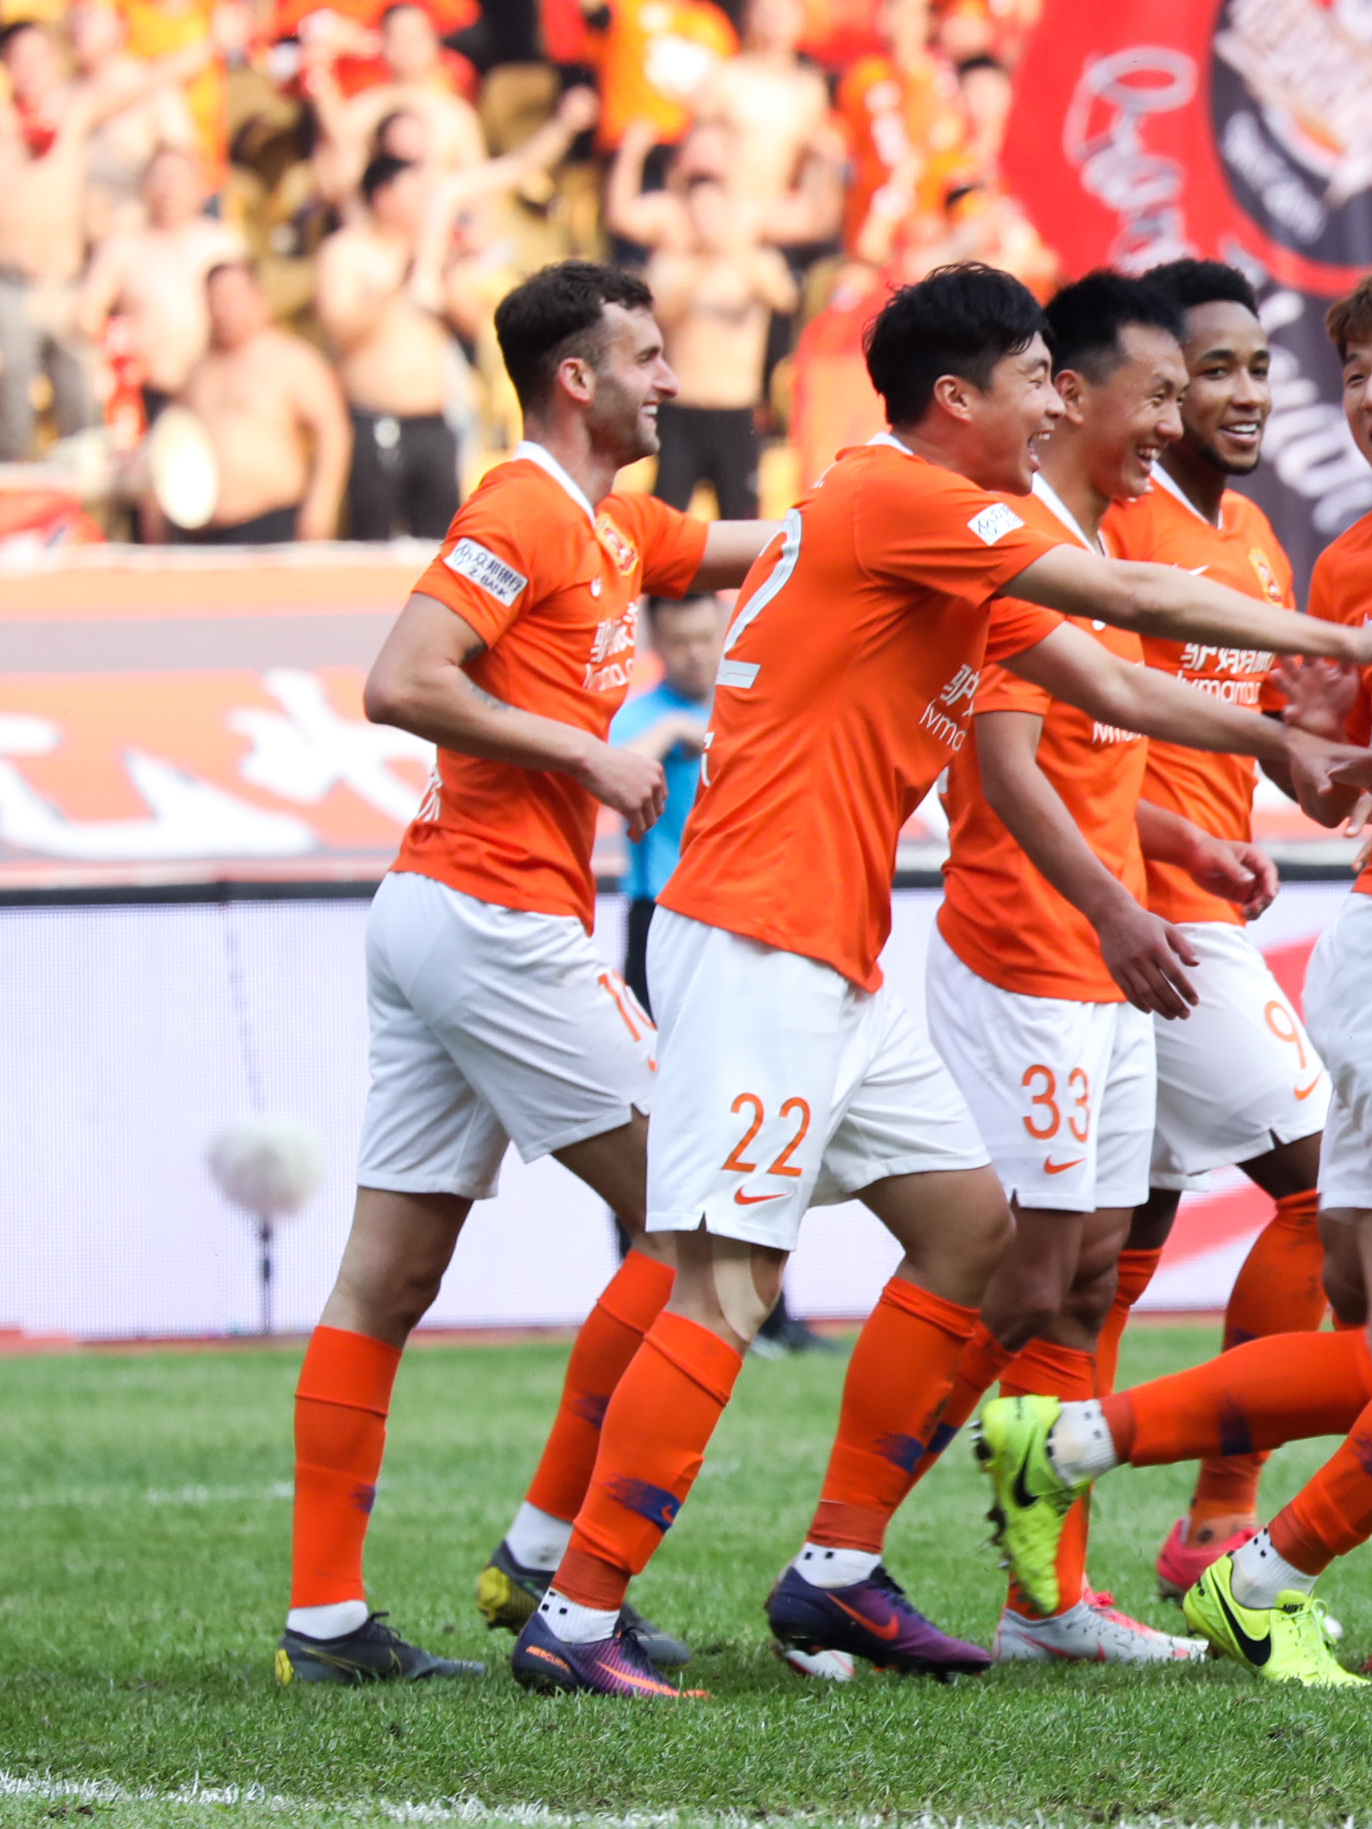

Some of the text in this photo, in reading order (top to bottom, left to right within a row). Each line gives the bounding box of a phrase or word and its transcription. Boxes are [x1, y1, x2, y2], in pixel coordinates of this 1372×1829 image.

[1263, 1000, 1307, 1069] 9
[720, 1092, 811, 1177] 22
[1021, 1064, 1089, 1143] 33
